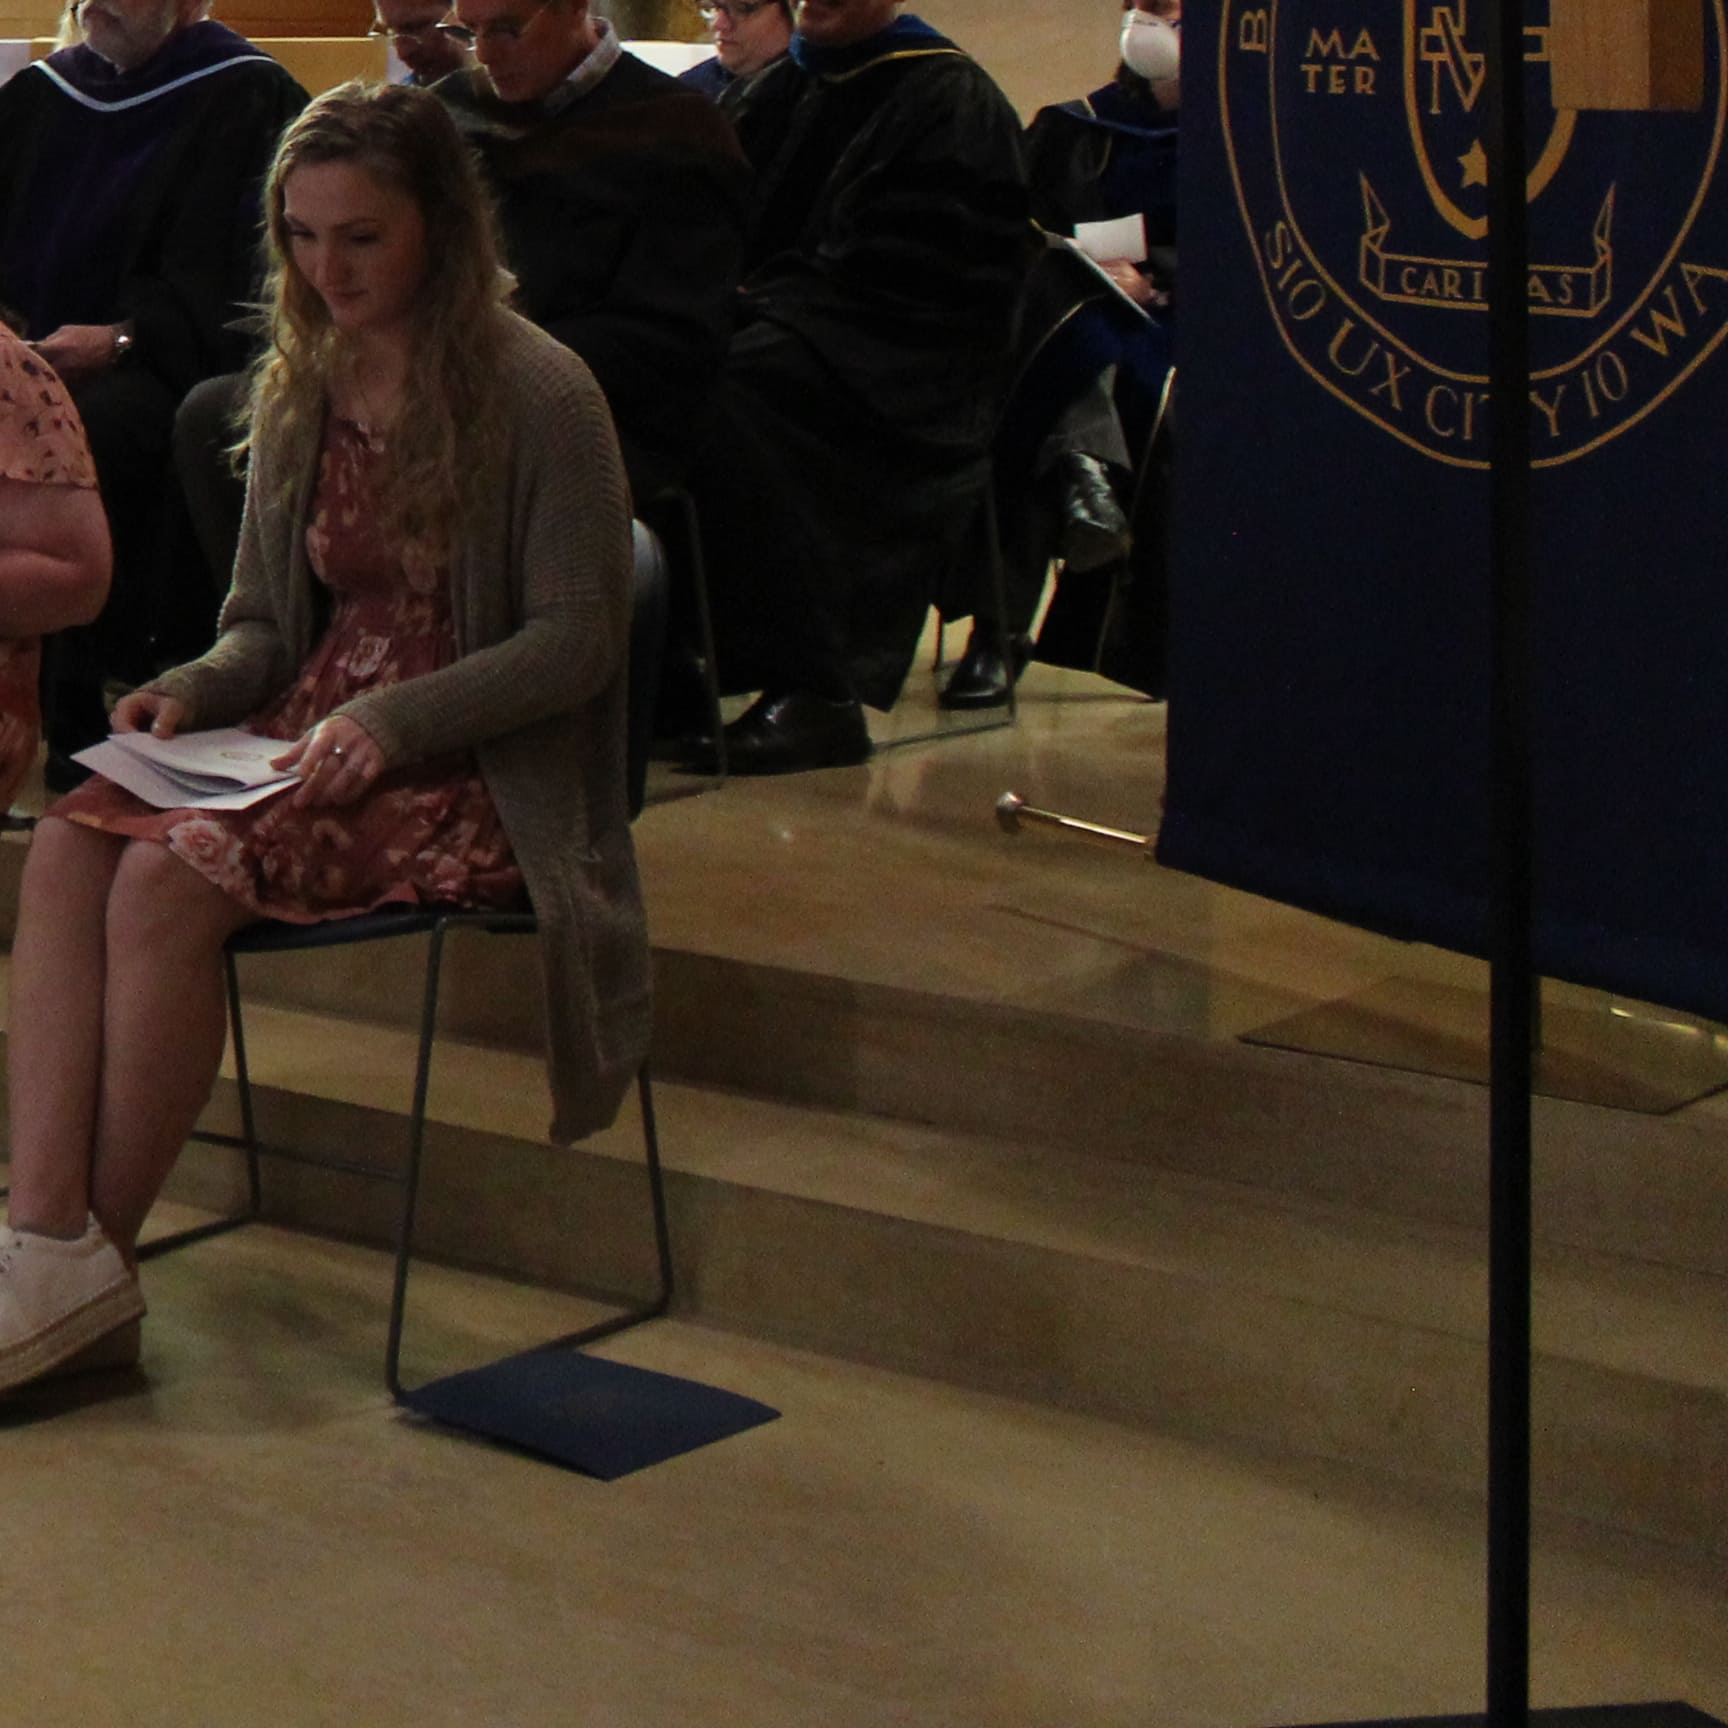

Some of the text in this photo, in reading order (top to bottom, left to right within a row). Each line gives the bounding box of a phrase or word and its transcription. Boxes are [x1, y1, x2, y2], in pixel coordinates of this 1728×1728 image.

[1306, 28, 1381, 62] MA
[1300, 64, 1377, 95] TER
[1400, 266, 1576, 306] CARIAS
[1424, 384, 1568, 441] CIY
